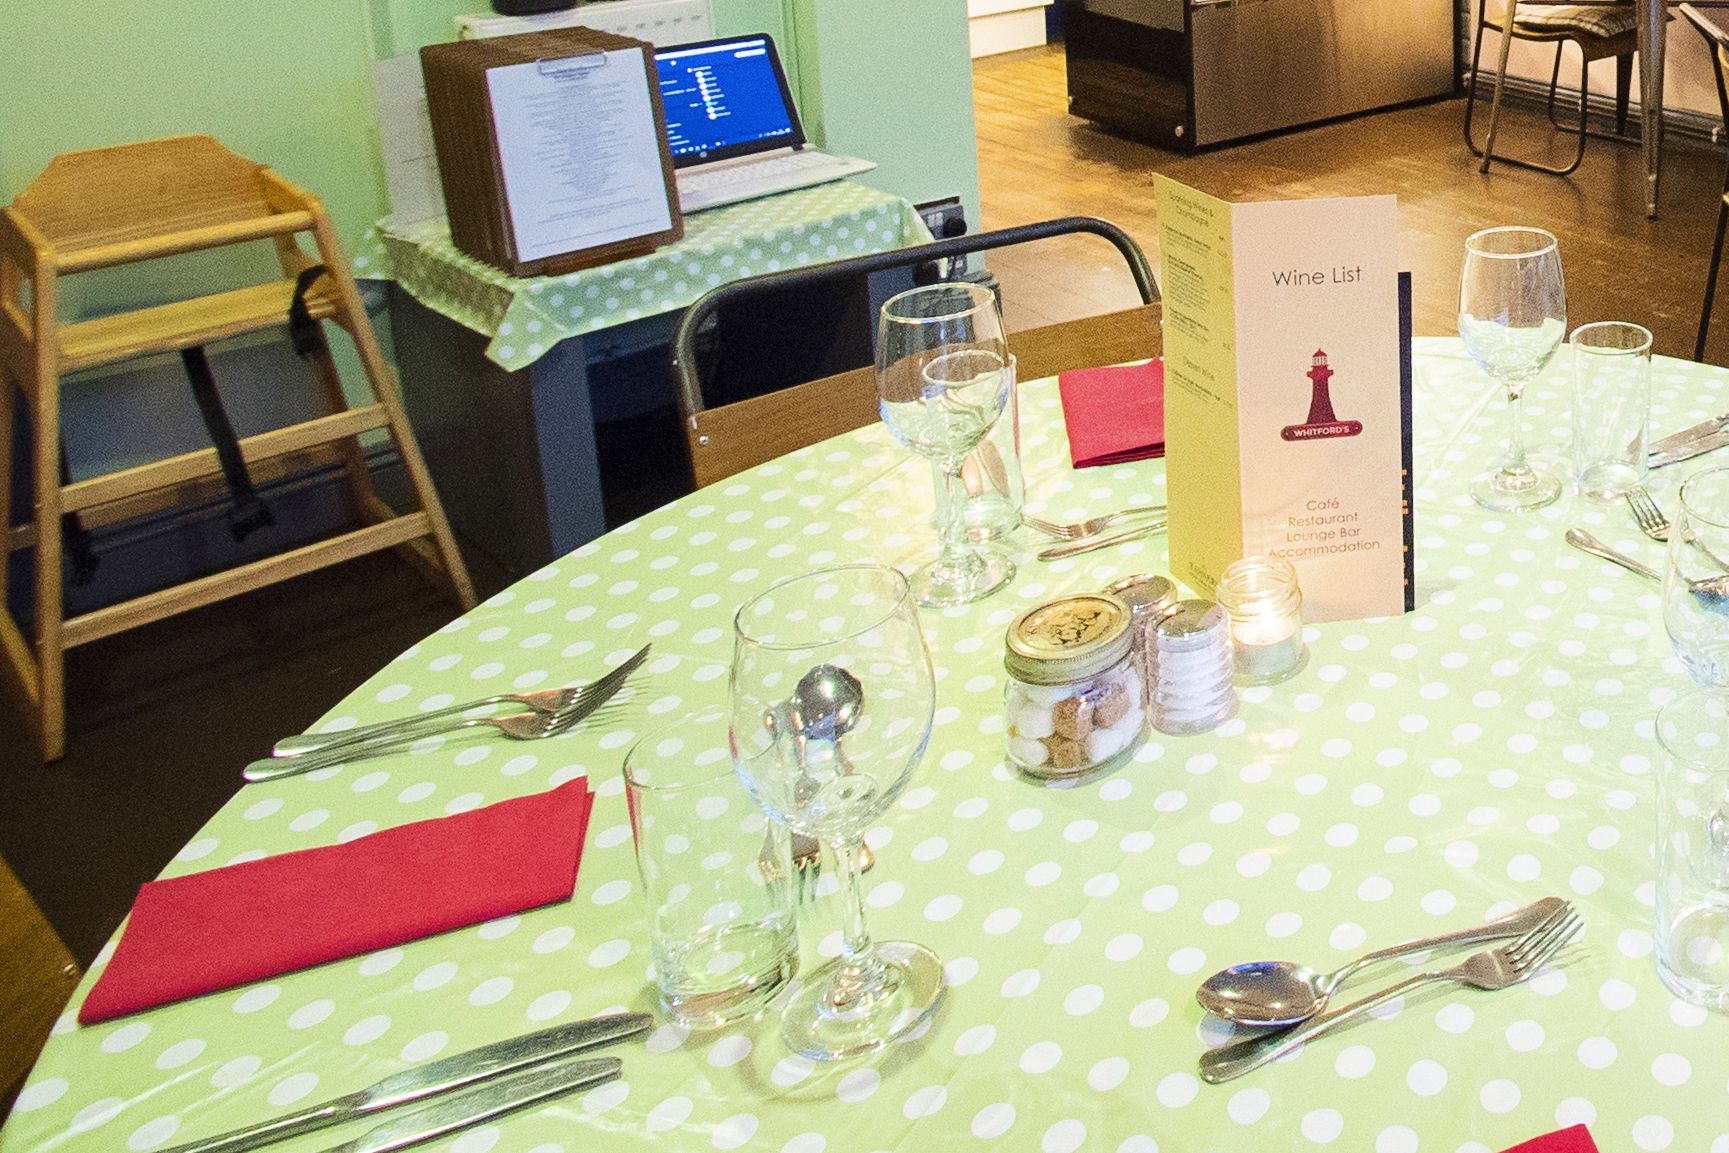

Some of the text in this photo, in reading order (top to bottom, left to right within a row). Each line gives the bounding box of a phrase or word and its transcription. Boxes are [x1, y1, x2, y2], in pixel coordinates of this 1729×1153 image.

[1272, 265, 1362, 286] Wine List
[1293, 425, 1350, 437] WHITFORD'S
[1306, 497, 1340, 511] Café
[1288, 512, 1358, 527] Restaurant
[1286, 527, 1361, 543] Lounge Bar
[1269, 540, 1381, 558] Accommodation
